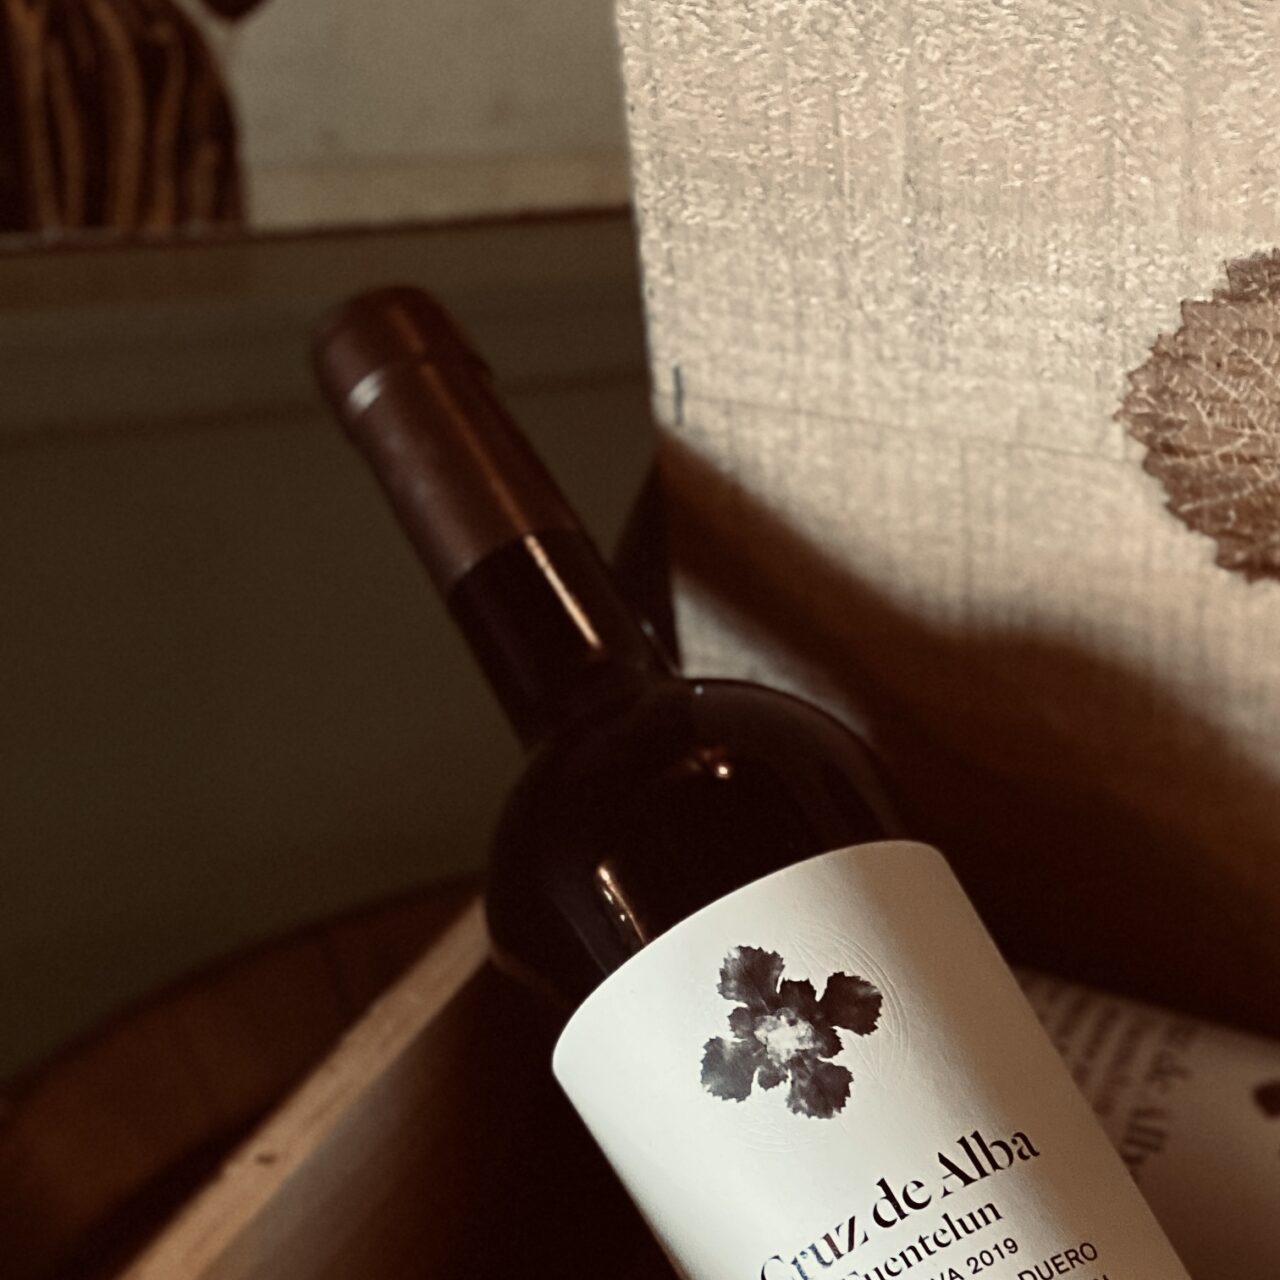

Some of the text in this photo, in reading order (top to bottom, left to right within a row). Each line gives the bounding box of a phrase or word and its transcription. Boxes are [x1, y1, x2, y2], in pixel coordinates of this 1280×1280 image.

[873, 1177, 932, 1228] de
[937, 1130, 1040, 1199] Alba
[966, 1237, 1019, 1275] 2019
